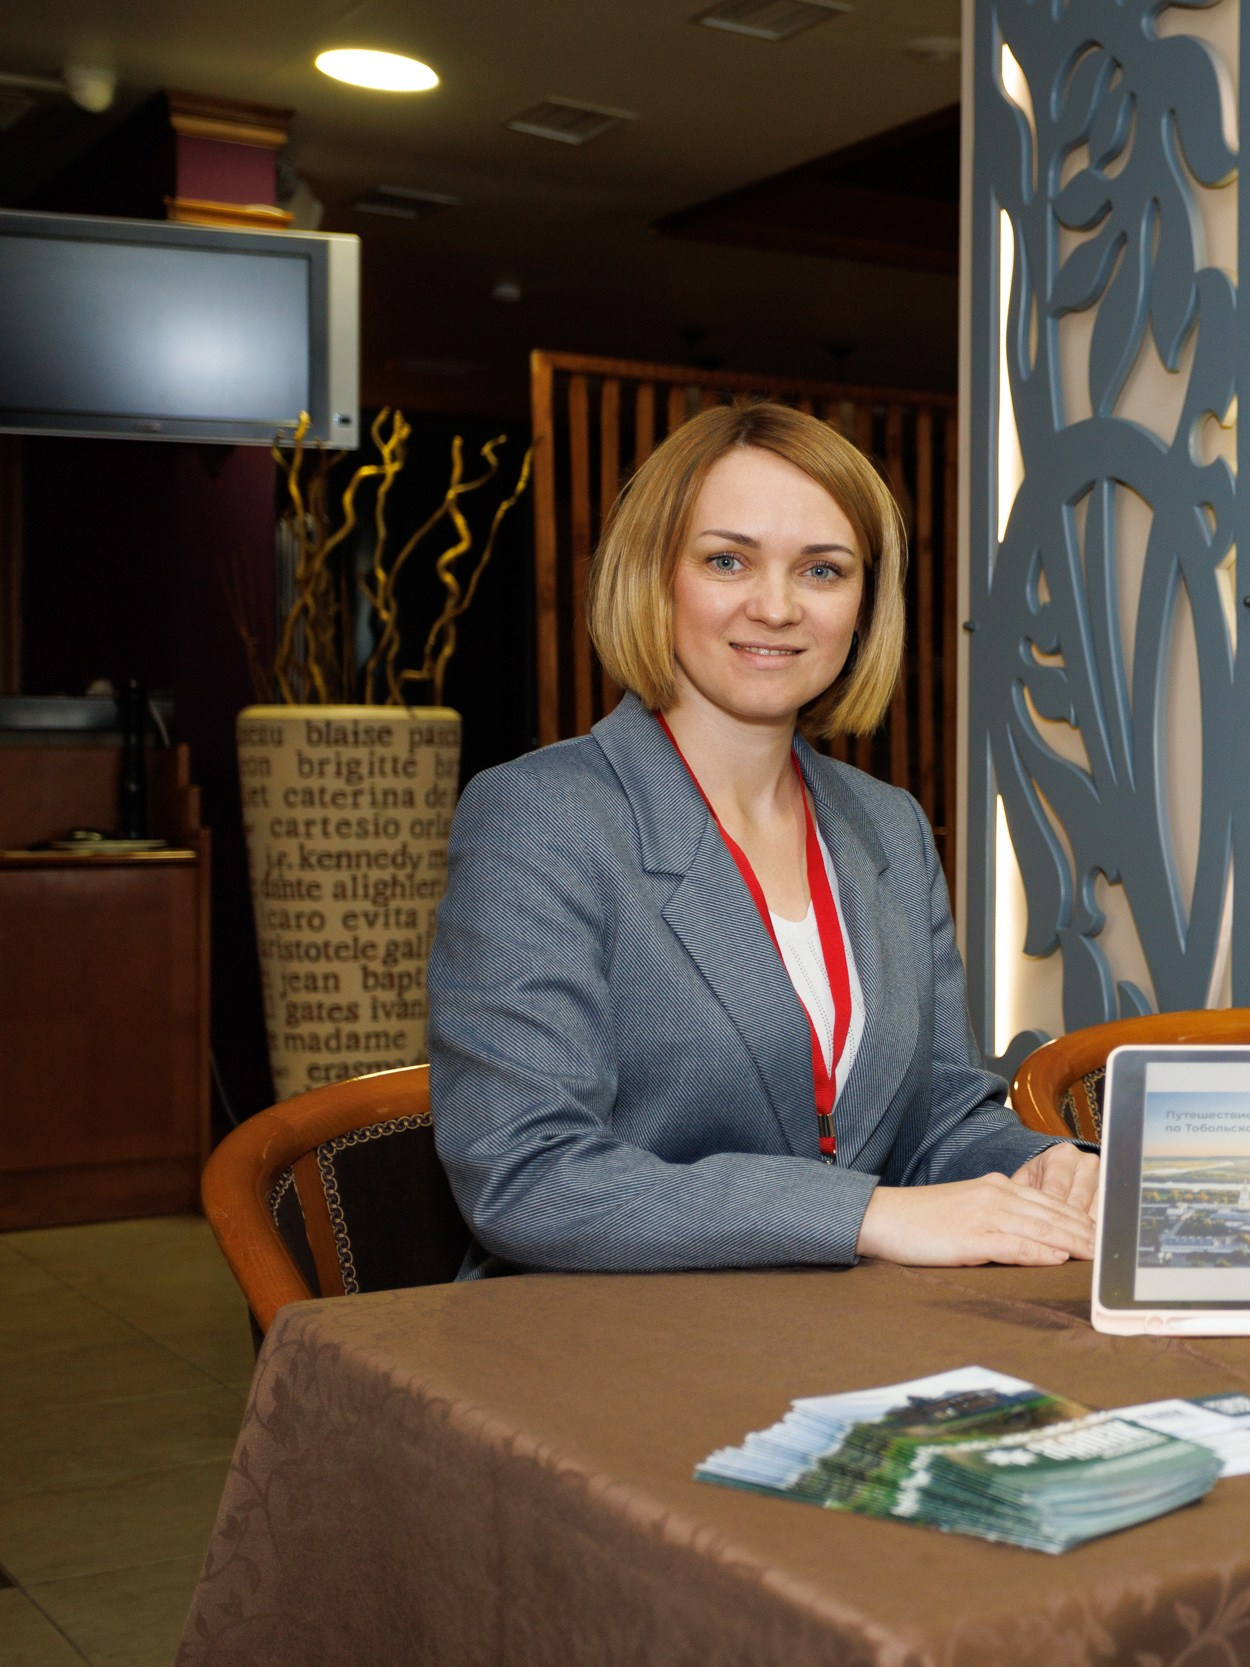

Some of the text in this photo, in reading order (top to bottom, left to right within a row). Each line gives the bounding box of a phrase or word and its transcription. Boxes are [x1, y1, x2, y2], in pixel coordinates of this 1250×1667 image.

[306, 720, 393, 747] blaise
[298, 752, 418, 786] brigitte
[283, 786, 416, 809] caterina
[269, 813, 400, 840] cartesio
[300, 845, 422, 875] kennedy
[342, 907, 418, 931] evita
[280, 966, 340, 998] jean
[286, 1000, 359, 1028] gates
[283, 1027, 407, 1054] madame
[1165, 1124, 1182, 1133] по
